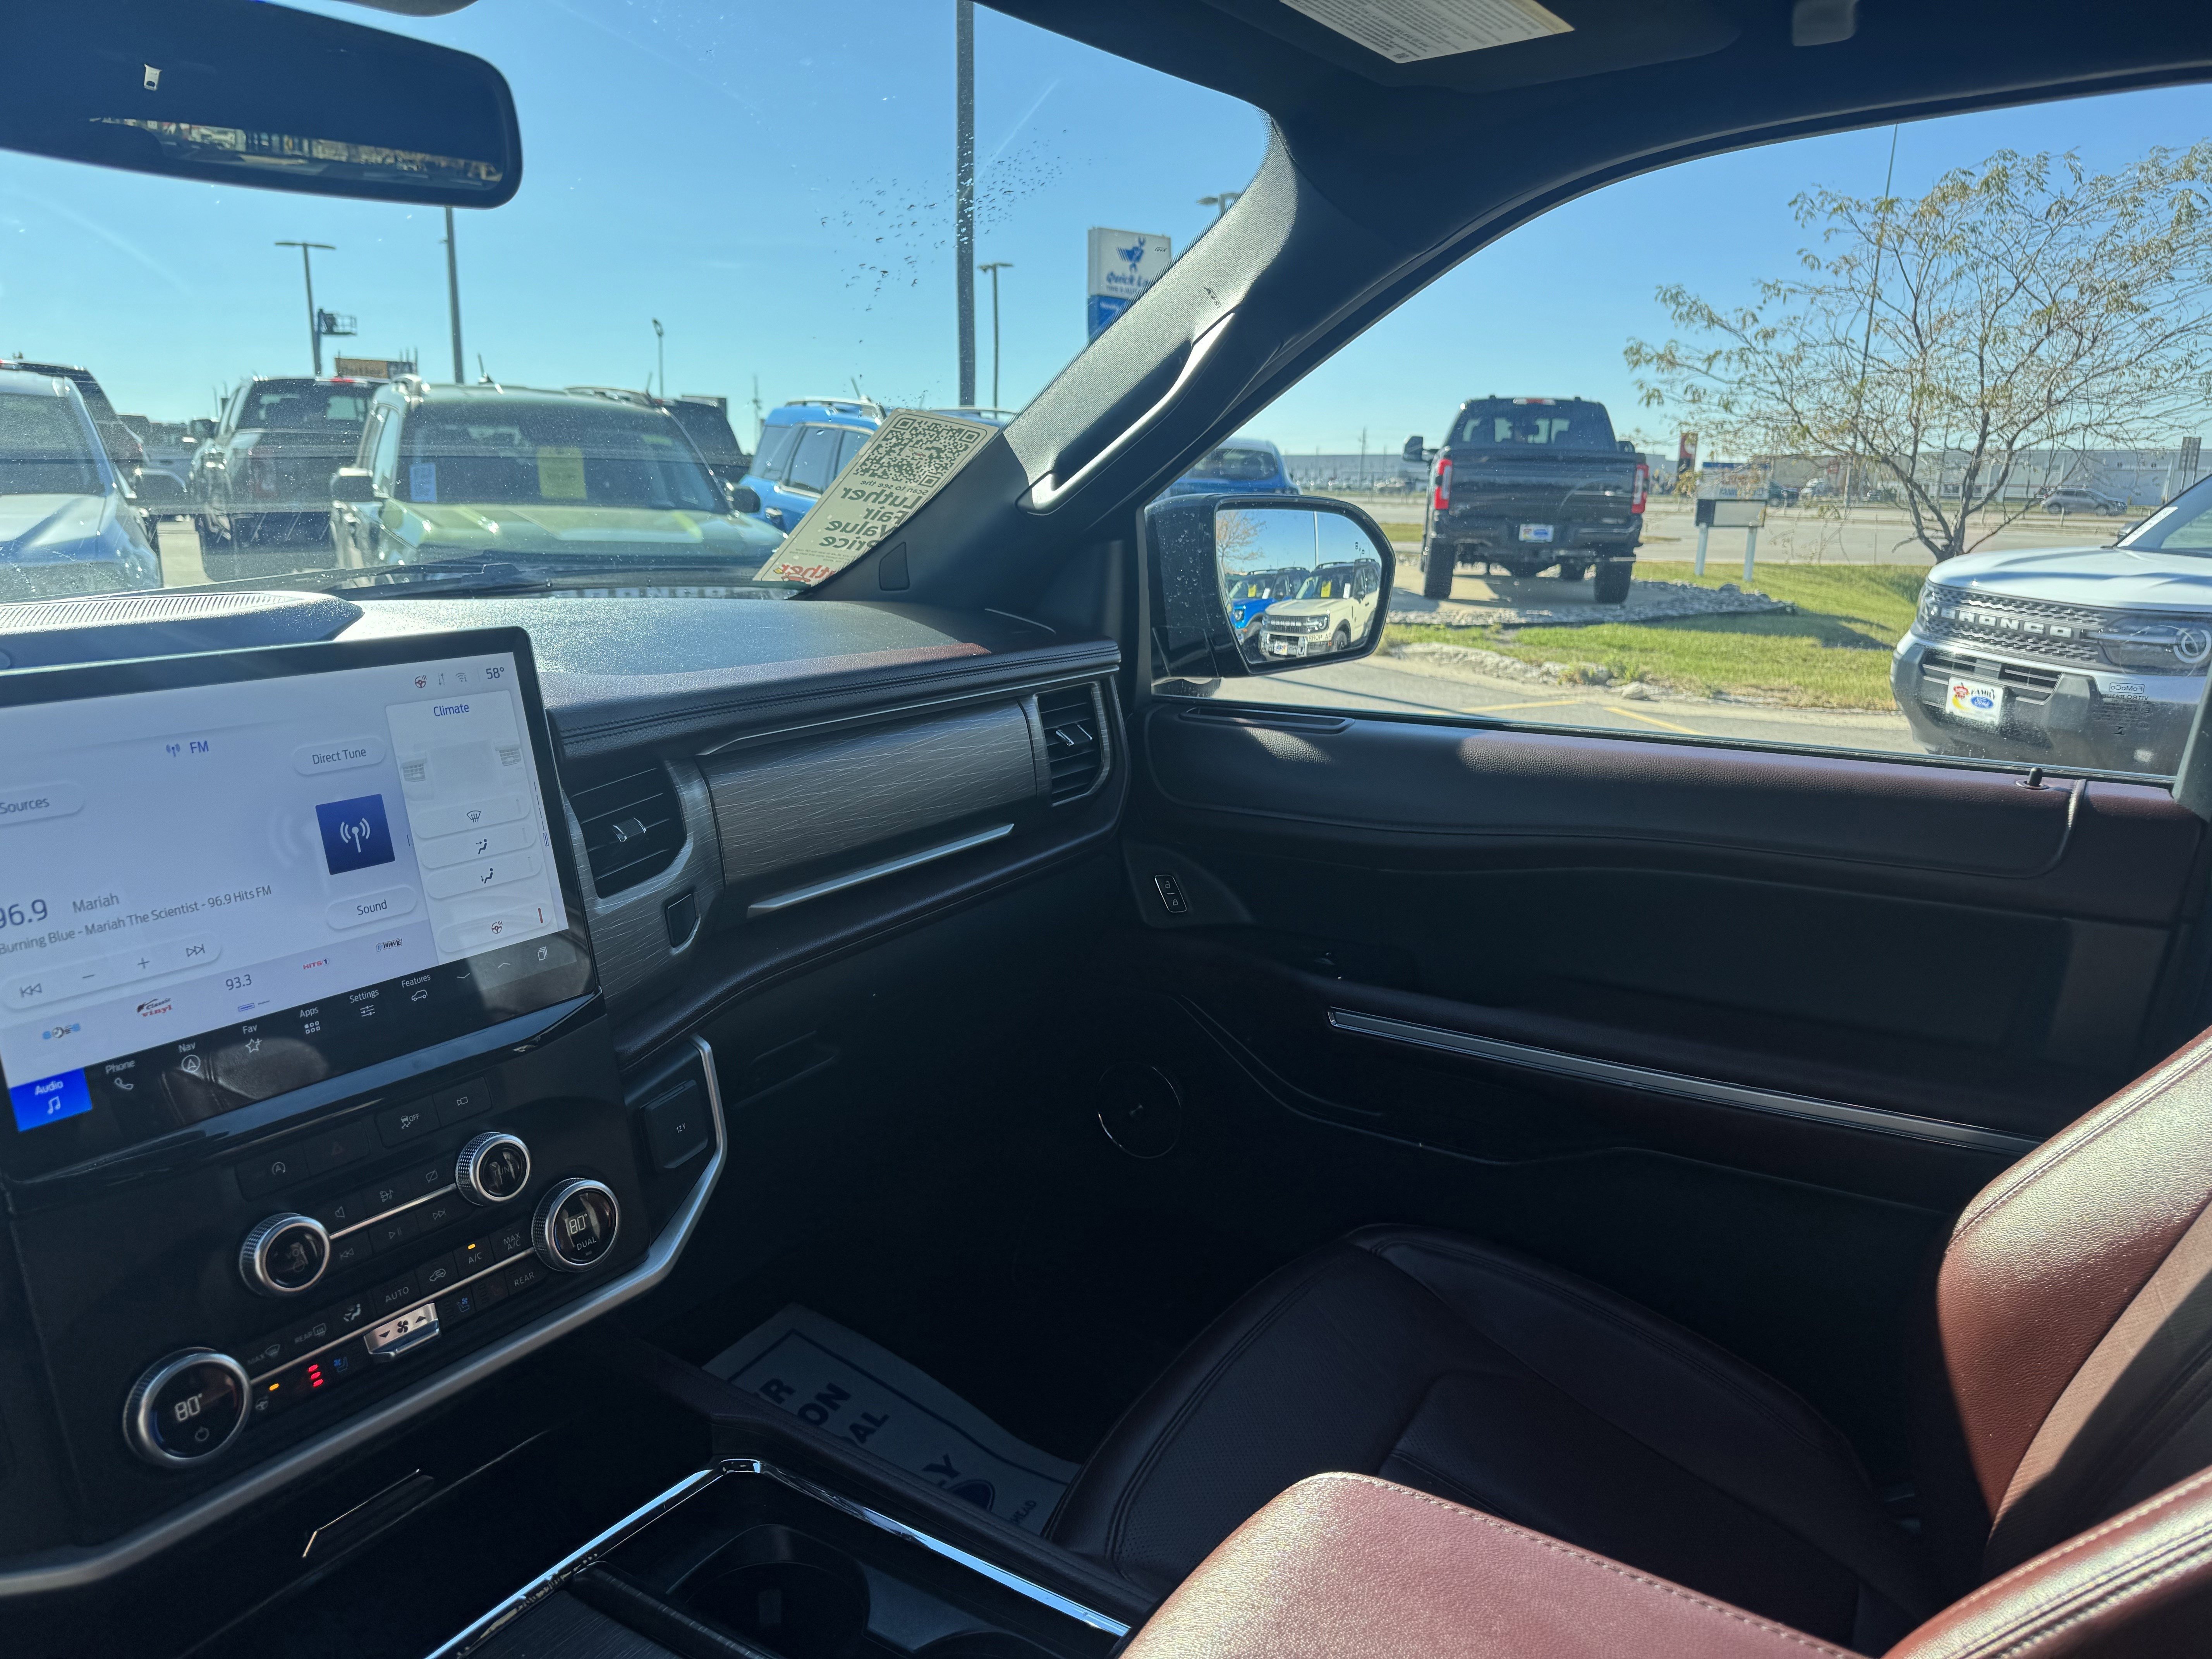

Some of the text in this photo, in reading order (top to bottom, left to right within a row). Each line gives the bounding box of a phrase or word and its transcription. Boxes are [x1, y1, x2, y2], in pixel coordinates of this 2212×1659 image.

[1941, 607, 2072, 638] BRONCO
[486, 666, 504, 680] 58°
[433, 703, 470, 717] Climate
[190, 740, 210, 754] FM
[312, 747, 367, 765] Direct Tune
[0, 797, 50, 814] Sources
[72, 893, 120, 913] Mariah
[357, 899, 388, 915] Sound
[0, 936, 47, 955] Burning
[48, 929, 76, 944] Blue
[84, 917, 126, 936] Mariah
[126, 912, 150, 926] The
[151, 901, 200, 921] Scientist
[207, 893, 232, 908] 96.9
[233, 890, 255, 903] Hits
[255, 884, 272, 897] FM
[225, 974, 252, 991] 93.3
[401, 974, 431, 988] Features
[349, 988, 380, 1004] Settings
[299, 1006, 319, 1019] Apps
[242, 1024, 258, 1034] Fav
[178, 1042, 196, 1053] Nav
[105, 1059, 136, 1074] Phone
[34, 1079, 64, 1096] Audio
[409, 1113, 420, 1123] OFF
[503, 1232, 520, 1246] MAX
[507, 1239, 521, 1250] A/C
[577, 1236, 597, 1251] DUAL
[468, 1252, 483, 1264] A/C
[514, 1271, 534, 1287] REAR
[385, 1286, 409, 1303] AUTO
